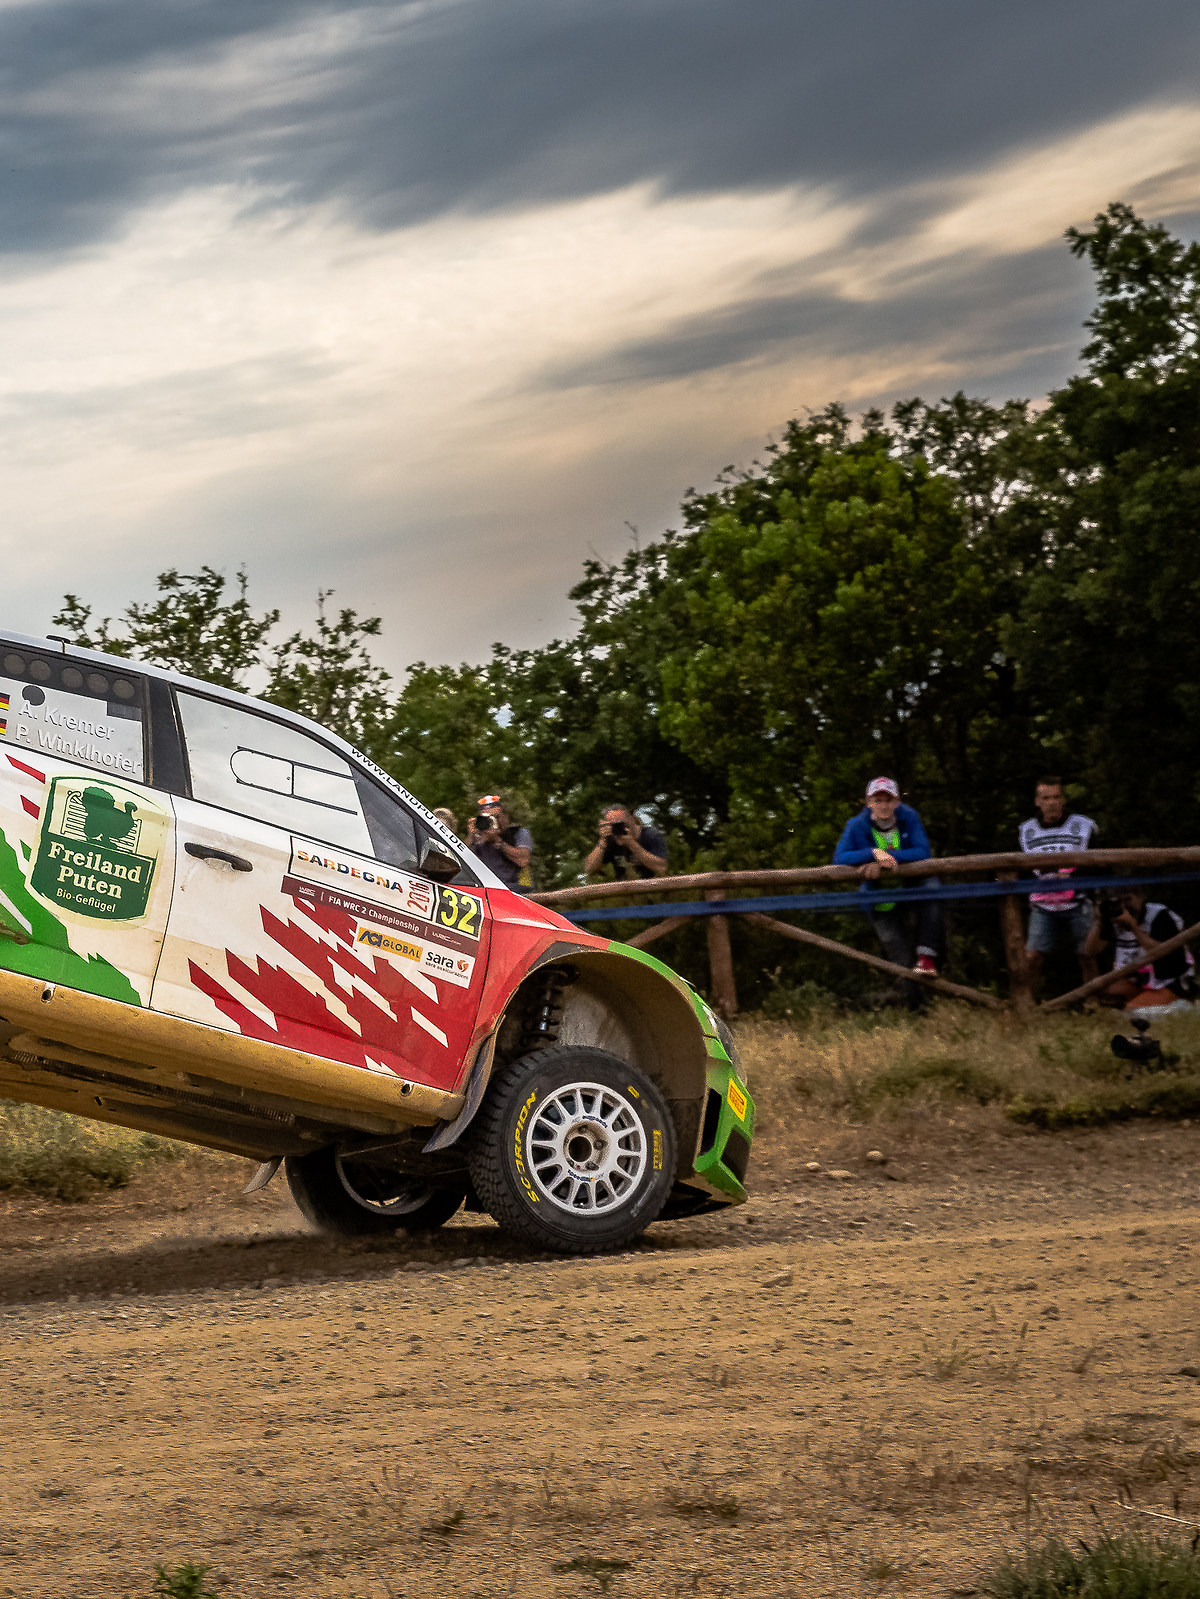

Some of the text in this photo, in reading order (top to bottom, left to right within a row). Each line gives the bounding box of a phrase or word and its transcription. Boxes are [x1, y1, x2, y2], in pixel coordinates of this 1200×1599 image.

[18, 700, 116, 740] A. Kremer
[15, 722, 144, 775] P. Winklhofer
[351, 748, 466, 853] WWW.LANDPUTE.DE
[48, 840, 142, 884] Freiland
[297, 850, 404, 894] SARDEGNA
[56, 887, 116, 913] Bio-Geflügel
[57, 865, 122, 899] Puten
[407, 879, 431, 913] 2016
[328, 895, 342, 906] FIA
[343, 900, 360, 912] WRC
[361, 906, 367, 914] 2
[368, 909, 420, 932] Championship
[440, 889, 478, 934] 32
[383, 939, 420, 959] GLOBAL
[426, 951, 454, 969] sara
